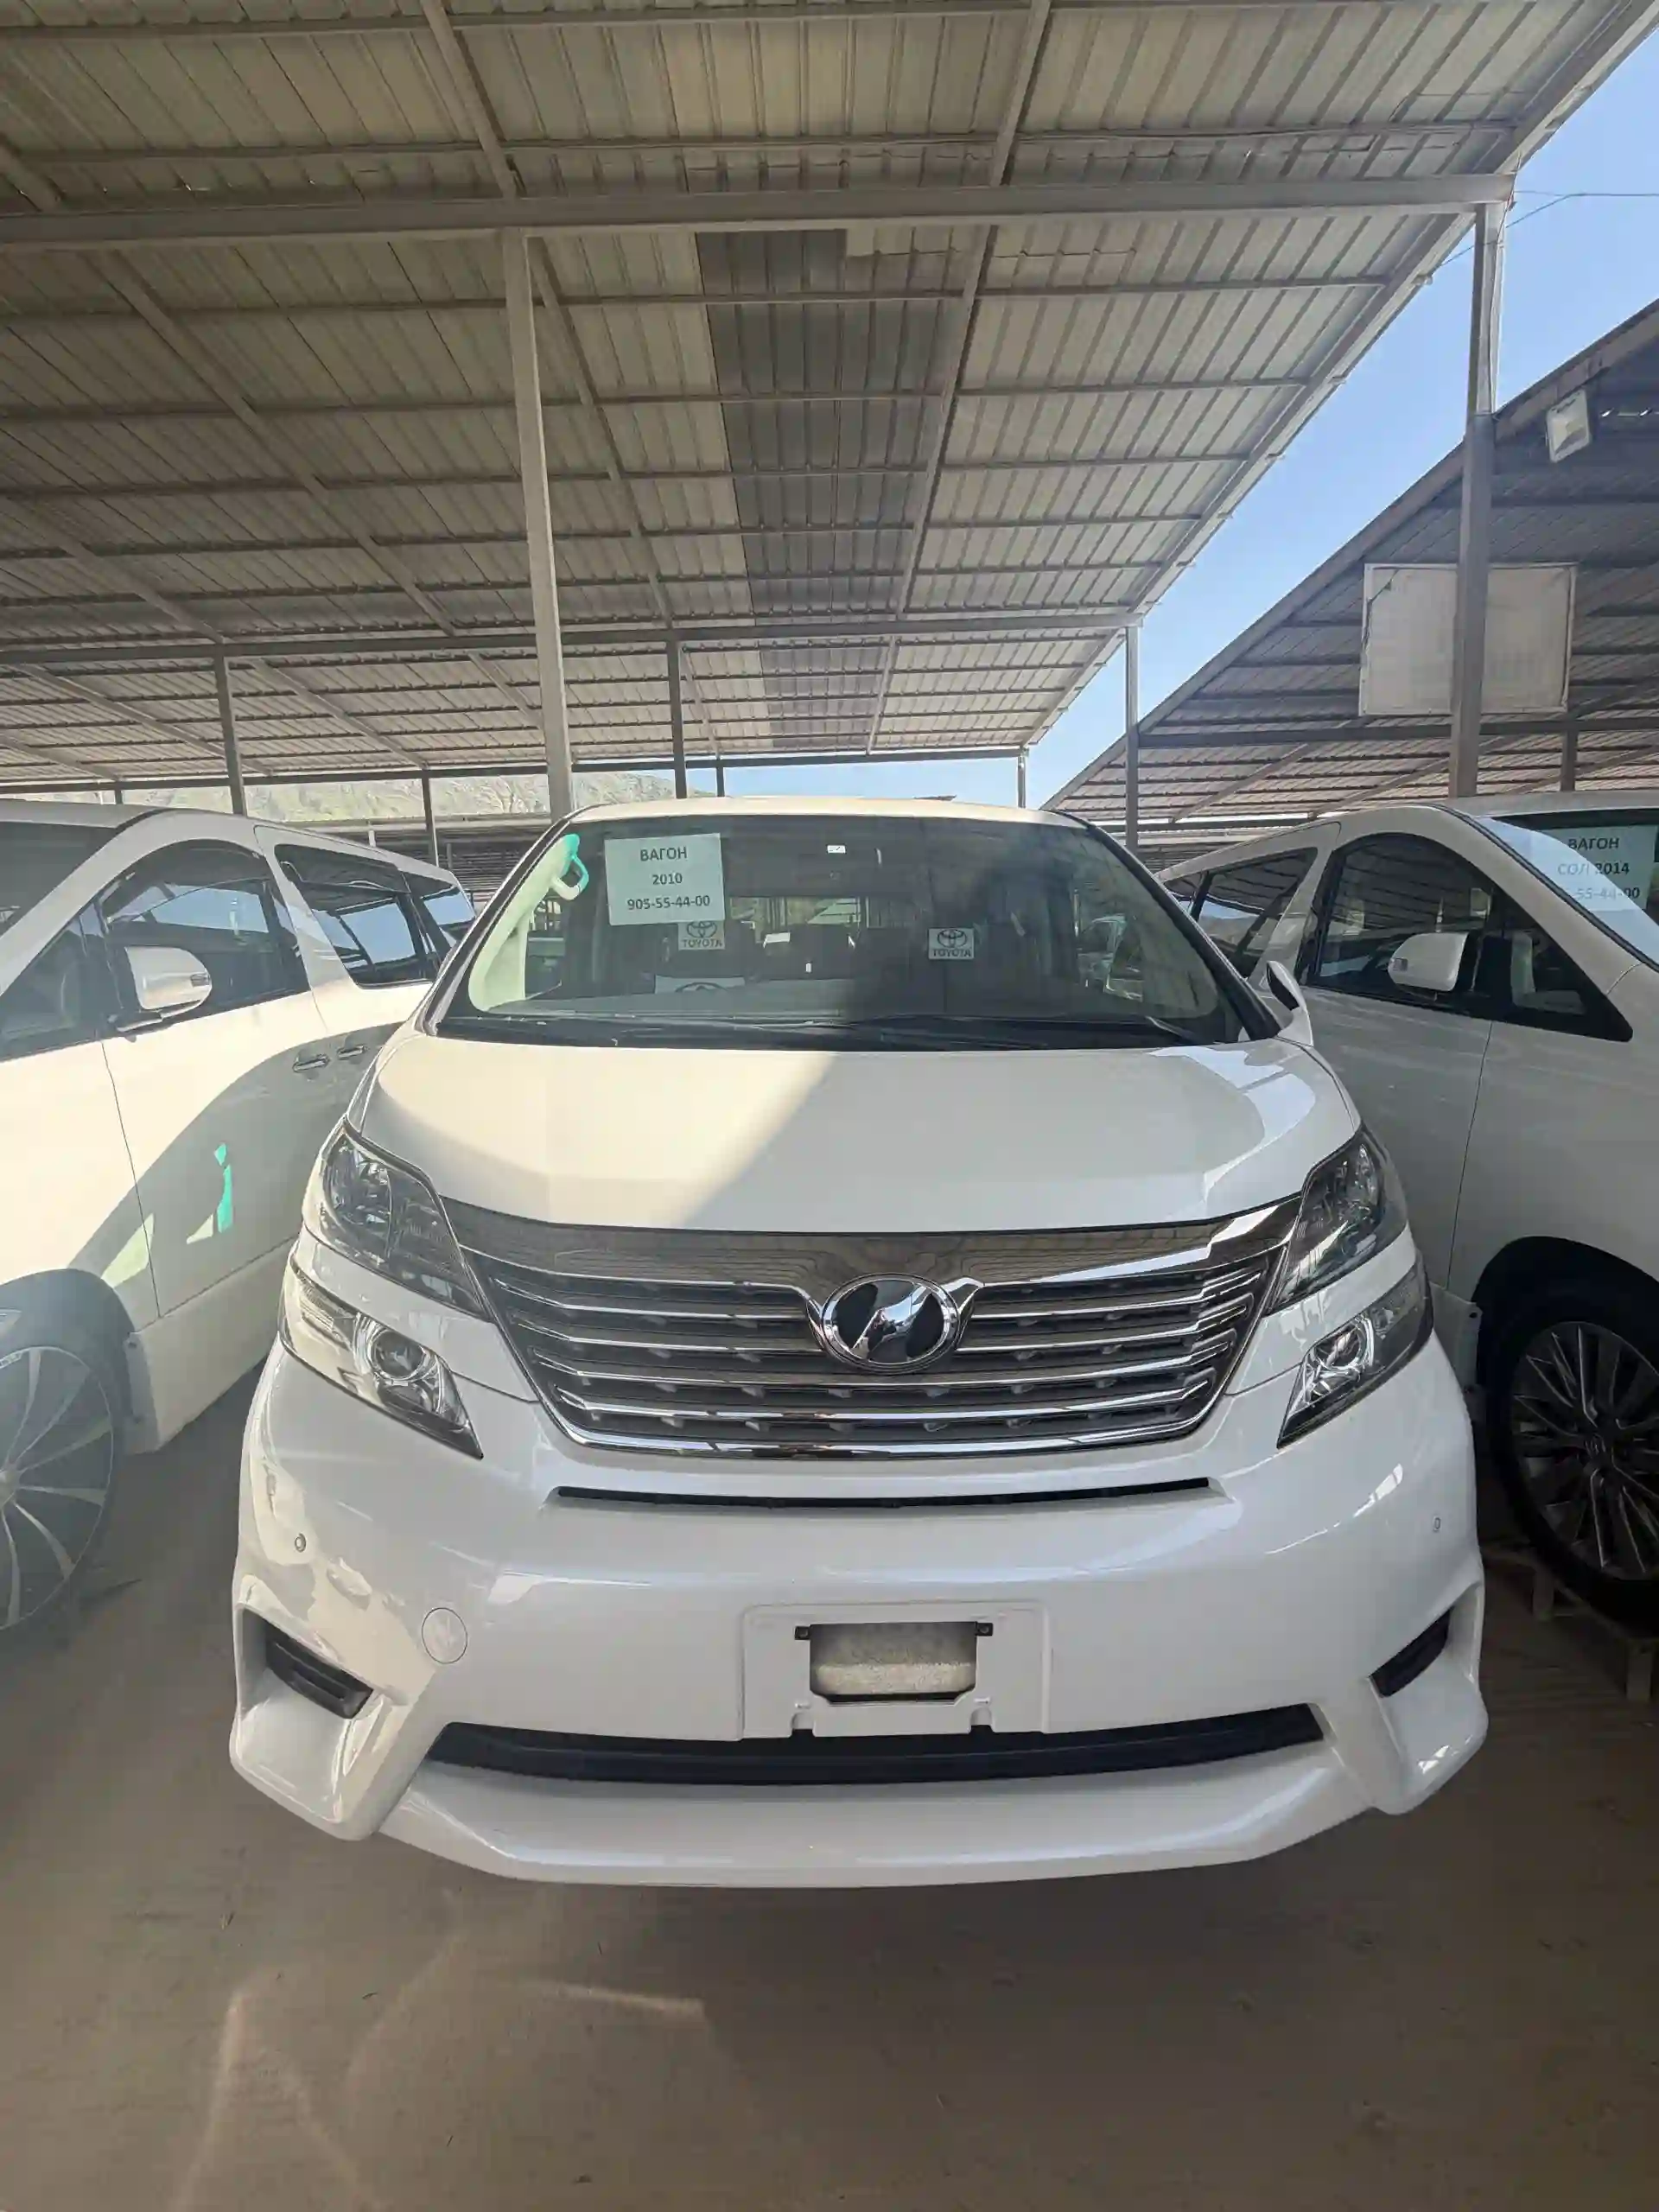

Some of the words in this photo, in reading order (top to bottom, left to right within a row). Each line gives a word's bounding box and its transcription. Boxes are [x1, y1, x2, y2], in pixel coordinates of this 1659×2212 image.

[1567, 837, 1620, 850] ВАГОН
[639, 846, 688, 862] ВАГОН
[1594, 861, 1630, 875] 2014
[652, 872, 683, 886] 2010
[626, 894, 711, 911] 905-55-44-00
[682, 938, 722, 948] TOYOTA
[932, 949, 971, 957] TOYOTA
